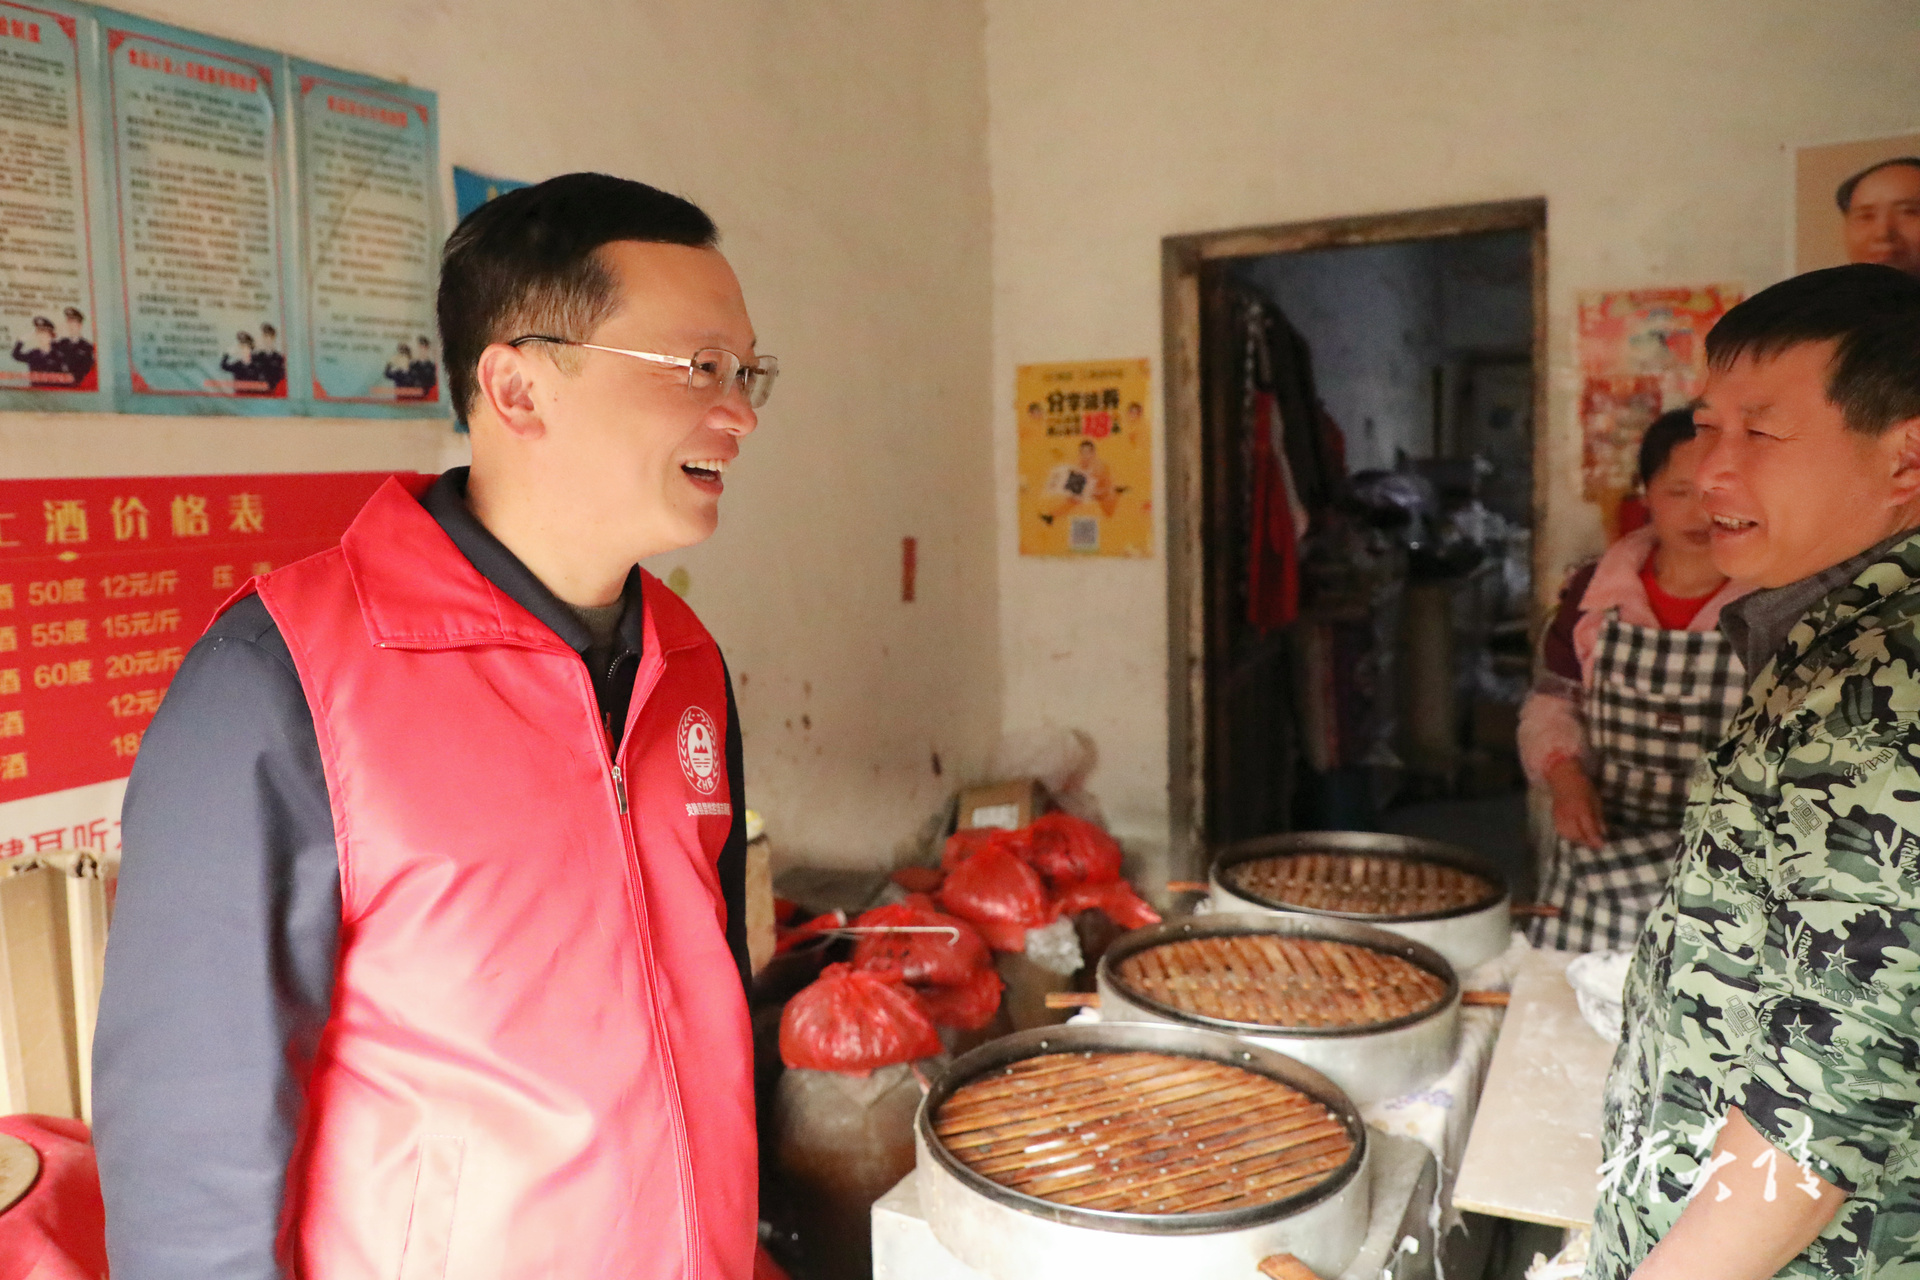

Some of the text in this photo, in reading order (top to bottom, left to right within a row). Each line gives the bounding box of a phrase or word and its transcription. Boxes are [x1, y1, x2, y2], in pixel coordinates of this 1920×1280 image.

[28, 578, 86, 606] 50度
[101, 570, 179, 598] 12元/斤
[31, 619, 87, 647] 55度
[102, 608, 181, 638] 15元/斤
[34, 659, 92, 689] 60度
[105, 647, 184, 679] 20元/斤
[0, 753, 28, 781] 酒
[696, 776, 714, 791] ZHB
